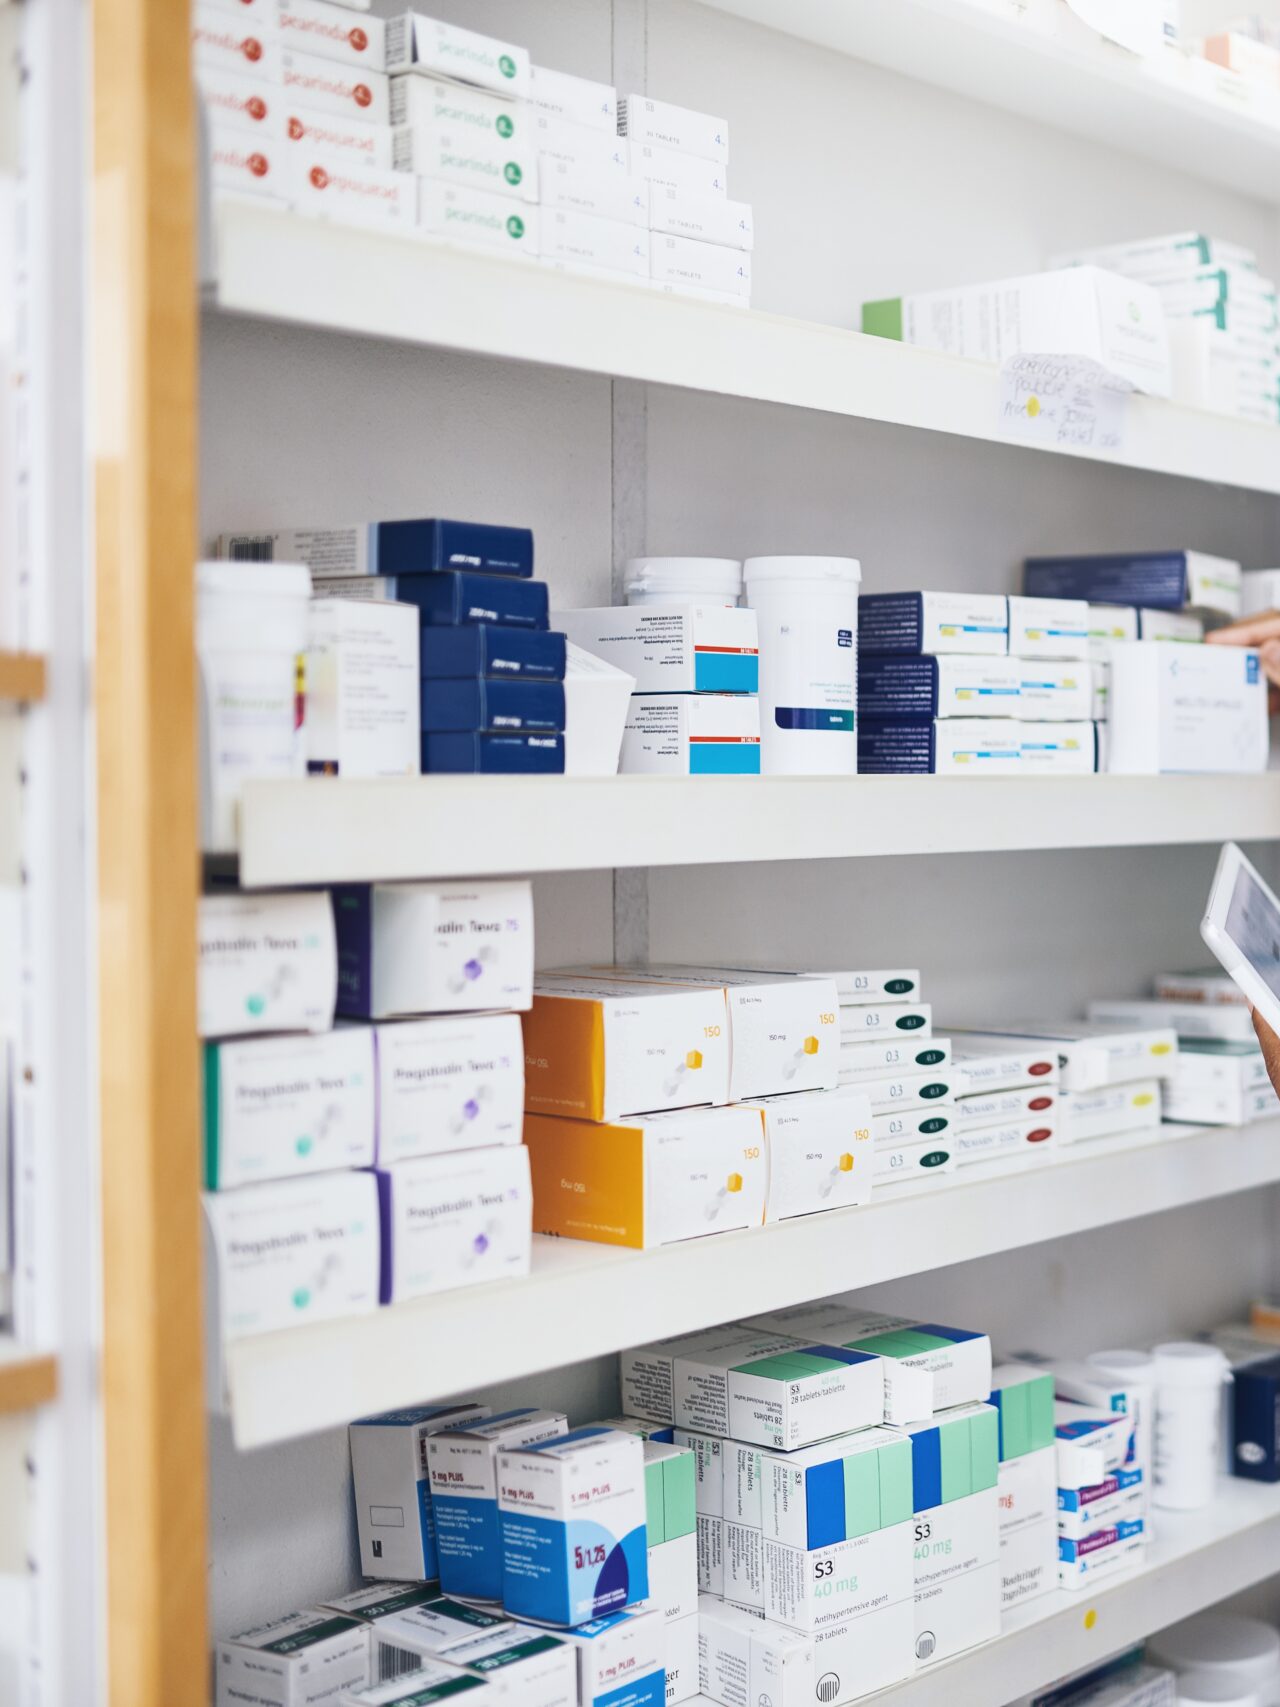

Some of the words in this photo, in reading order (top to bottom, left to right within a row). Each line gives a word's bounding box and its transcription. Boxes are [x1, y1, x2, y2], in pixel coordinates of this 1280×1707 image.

[856, 977, 868, 989] 0.3
[820, 1014, 835, 1025] 150
[867, 1015, 880, 1026] 0.3
[704, 1026, 720, 1037] 150
[886, 1050, 900, 1064] 0.3
[890, 1085, 904, 1098] 0.3
[889, 1120, 903, 1134] 0.3
[855, 1129, 870, 1140] 150
[744, 1148, 760, 1159] 150
[890, 1155, 903, 1168] 0.3
[754, 1412, 773, 1422] tablets
[775, 1417, 782, 1425] 28
[698, 1440, 704, 1450] 28
[748, 1452, 753, 1462] 28
[432, 1471, 437, 1479] 5
[438, 1473, 447, 1482] mg
[448, 1473, 464, 1482] PLUS
[502, 1486, 506, 1496] 5
[508, 1489, 517, 1499] mg
[519, 1490, 534, 1500] PLUS
[571, 1494, 576, 1502] 5
[578, 1491, 589, 1501] mg
[592, 1484, 610, 1496] PLUS
[914, 1524, 930, 1541] S3
[914, 1545, 929, 1560] 40
[933, 1539, 952, 1555] mg
[815, 1560, 833, 1578] S3
[814, 1581, 832, 1598] 40
[837, 1576, 858, 1592] mg
[914, 1594, 921, 1602] 28
[923, 1587, 942, 1598] tablets
[815, 1601, 870, 1624] Antihypertensive
[871, 1594, 888, 1608] agent
[815, 1634, 824, 1642] 28
[826, 1627, 848, 1639] tablets
[606, 1668, 616, 1676] mg
[618, 1657, 635, 1670] PLUS
